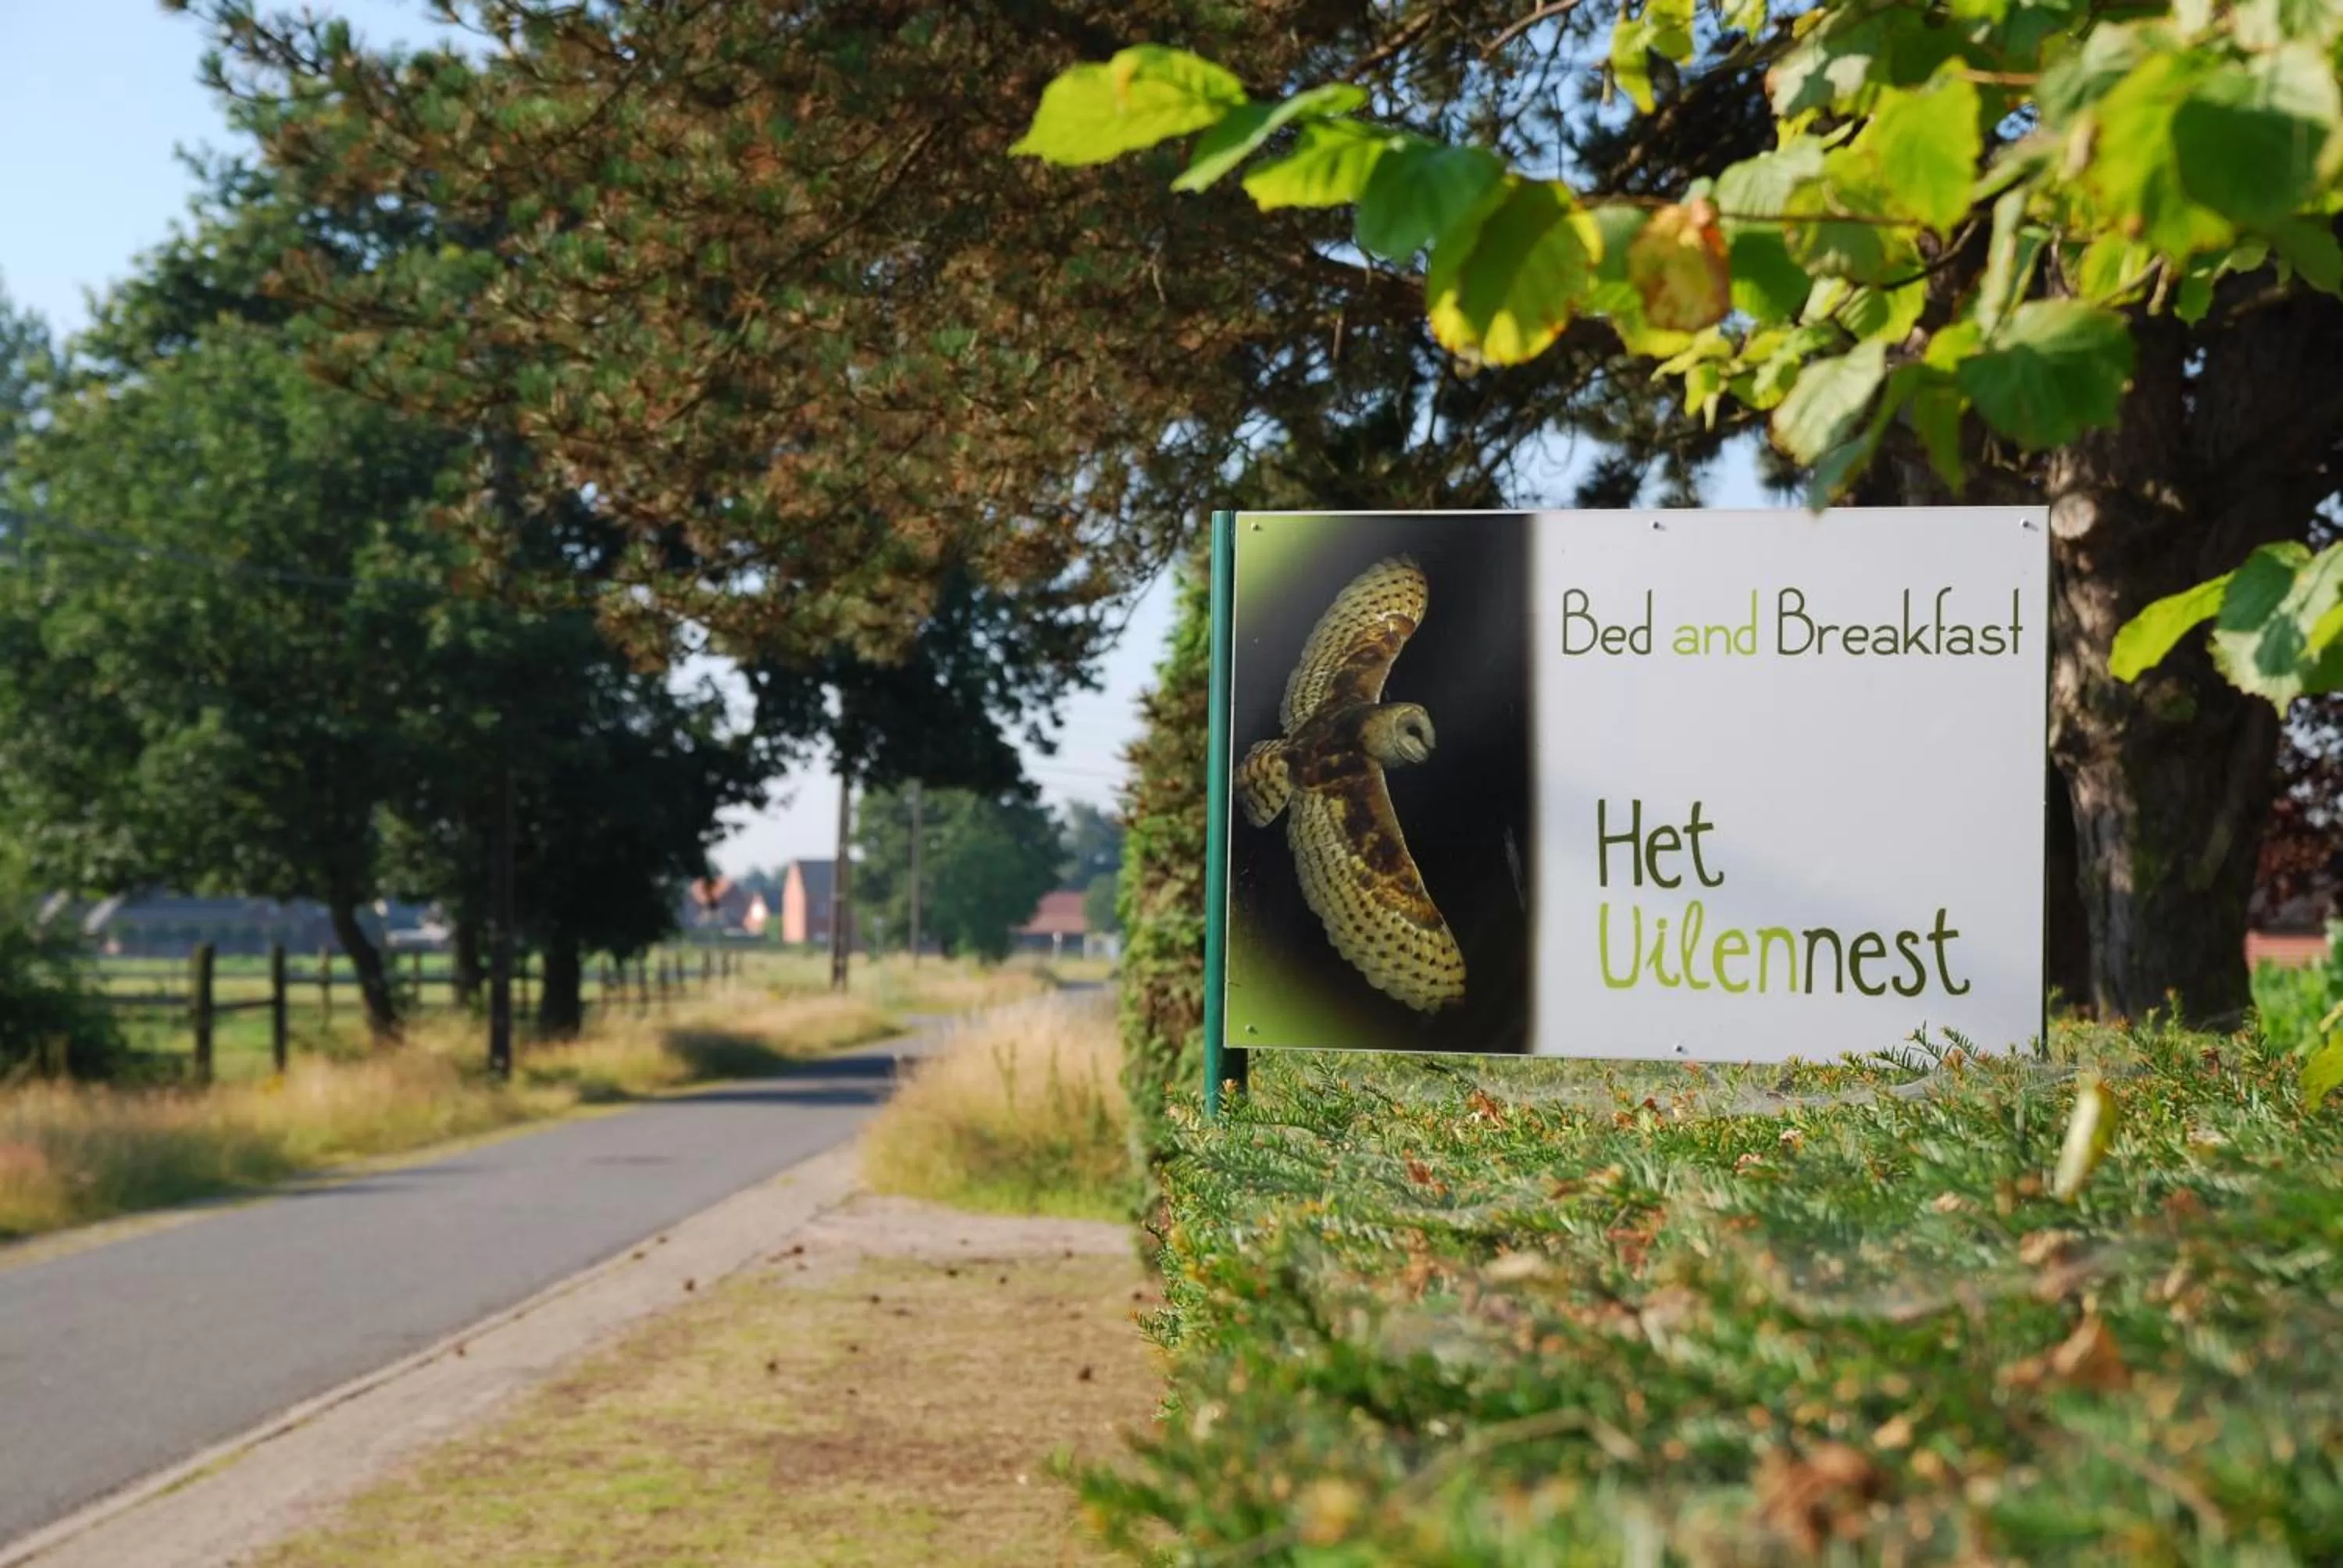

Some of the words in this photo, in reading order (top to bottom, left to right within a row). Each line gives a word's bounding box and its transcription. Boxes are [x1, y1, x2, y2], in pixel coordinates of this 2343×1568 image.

[1563, 588, 1652, 655] Bed
[1673, 589, 1757, 655] and
[1778, 586, 2024, 656] Breakfast
[1597, 799, 1725, 889] Het
[1599, 900, 1971, 998] Uilennest
